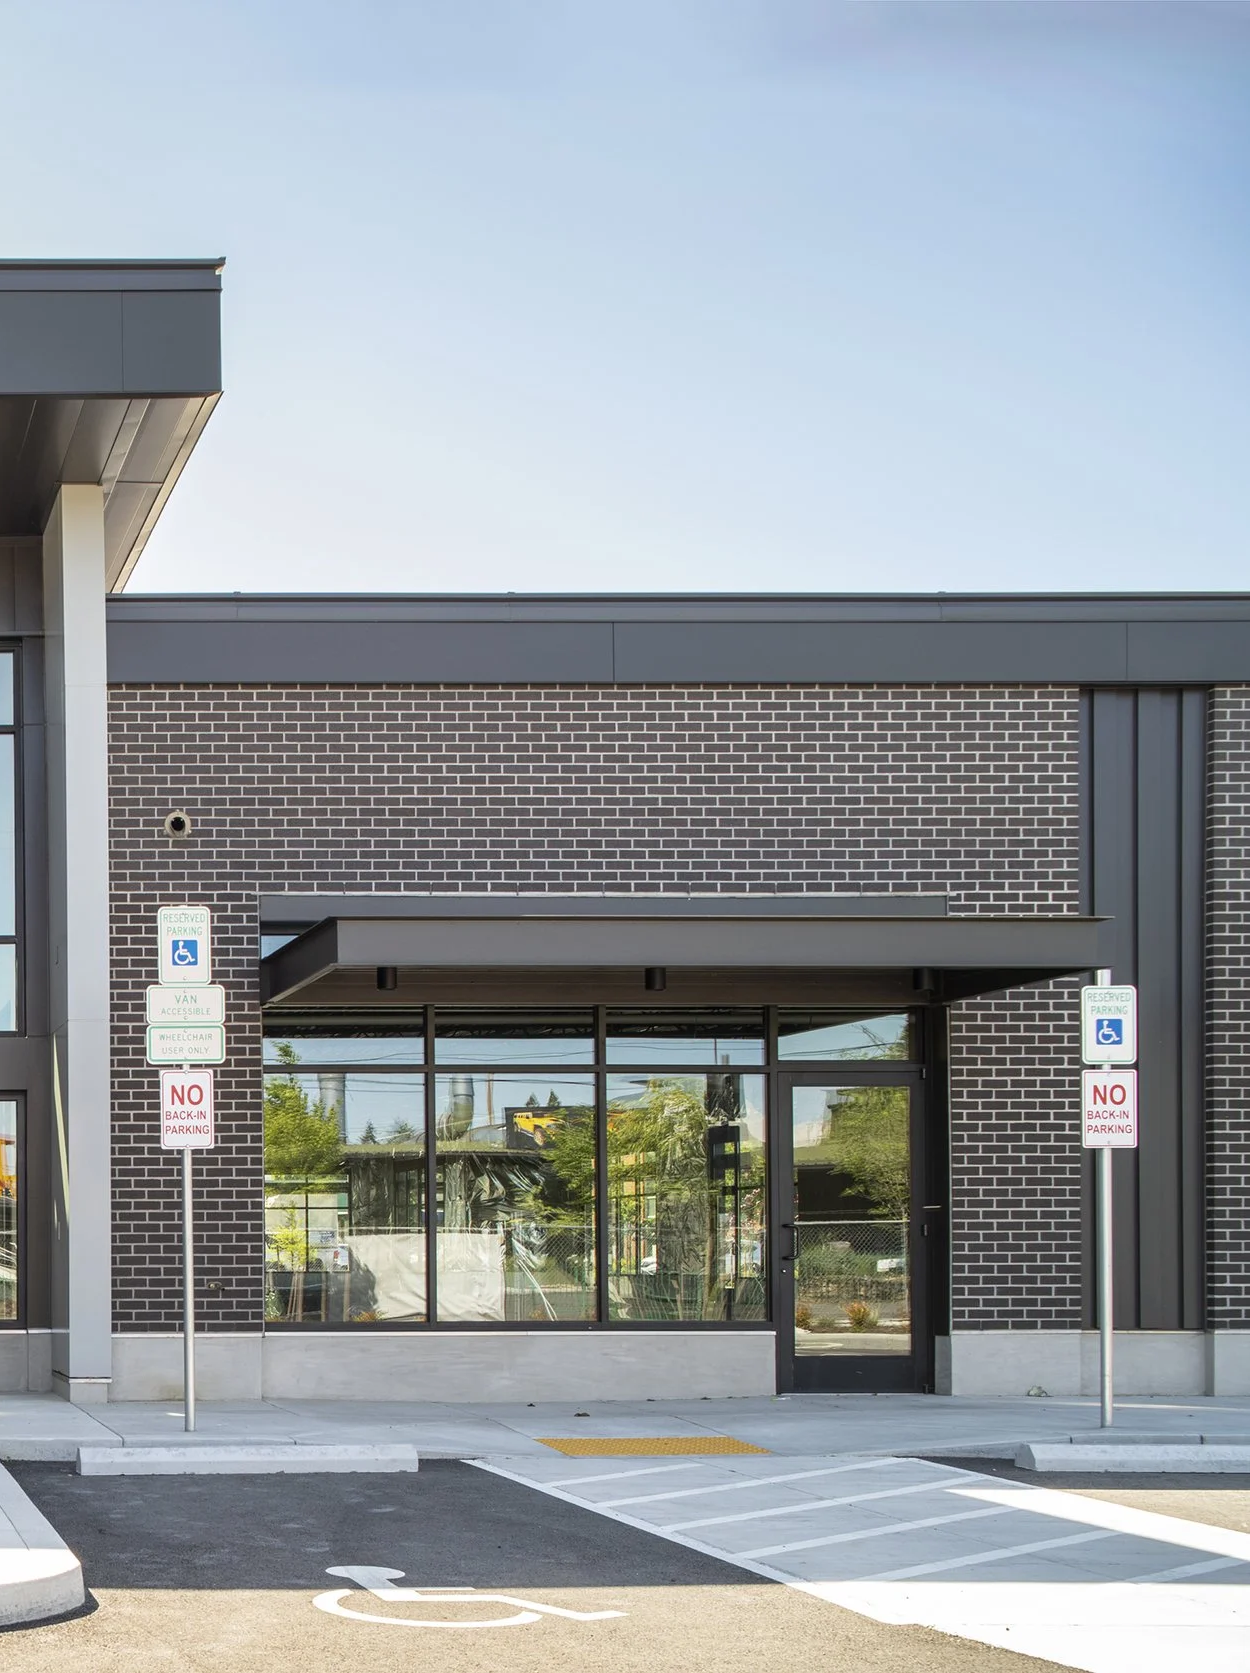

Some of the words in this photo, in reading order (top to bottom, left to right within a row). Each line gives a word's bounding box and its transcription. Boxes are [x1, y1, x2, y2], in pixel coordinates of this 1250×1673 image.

[163, 914, 205, 923] RESERVED
[167, 927, 202, 936] PARKING
[175, 995, 197, 1004] VAN
[1088, 992, 1130, 1002] RESERVED
[1091, 1006, 1128, 1015] PARKING
[171, 1084, 203, 1105] NO
[1093, 1084, 1126, 1105] NO
[165, 1111, 206, 1120] BACK-IN
[1087, 1110, 1129, 1120] BACK-IN
[165, 1125, 210, 1135] PARKING
[1087, 1124, 1132, 1134] PARKING
